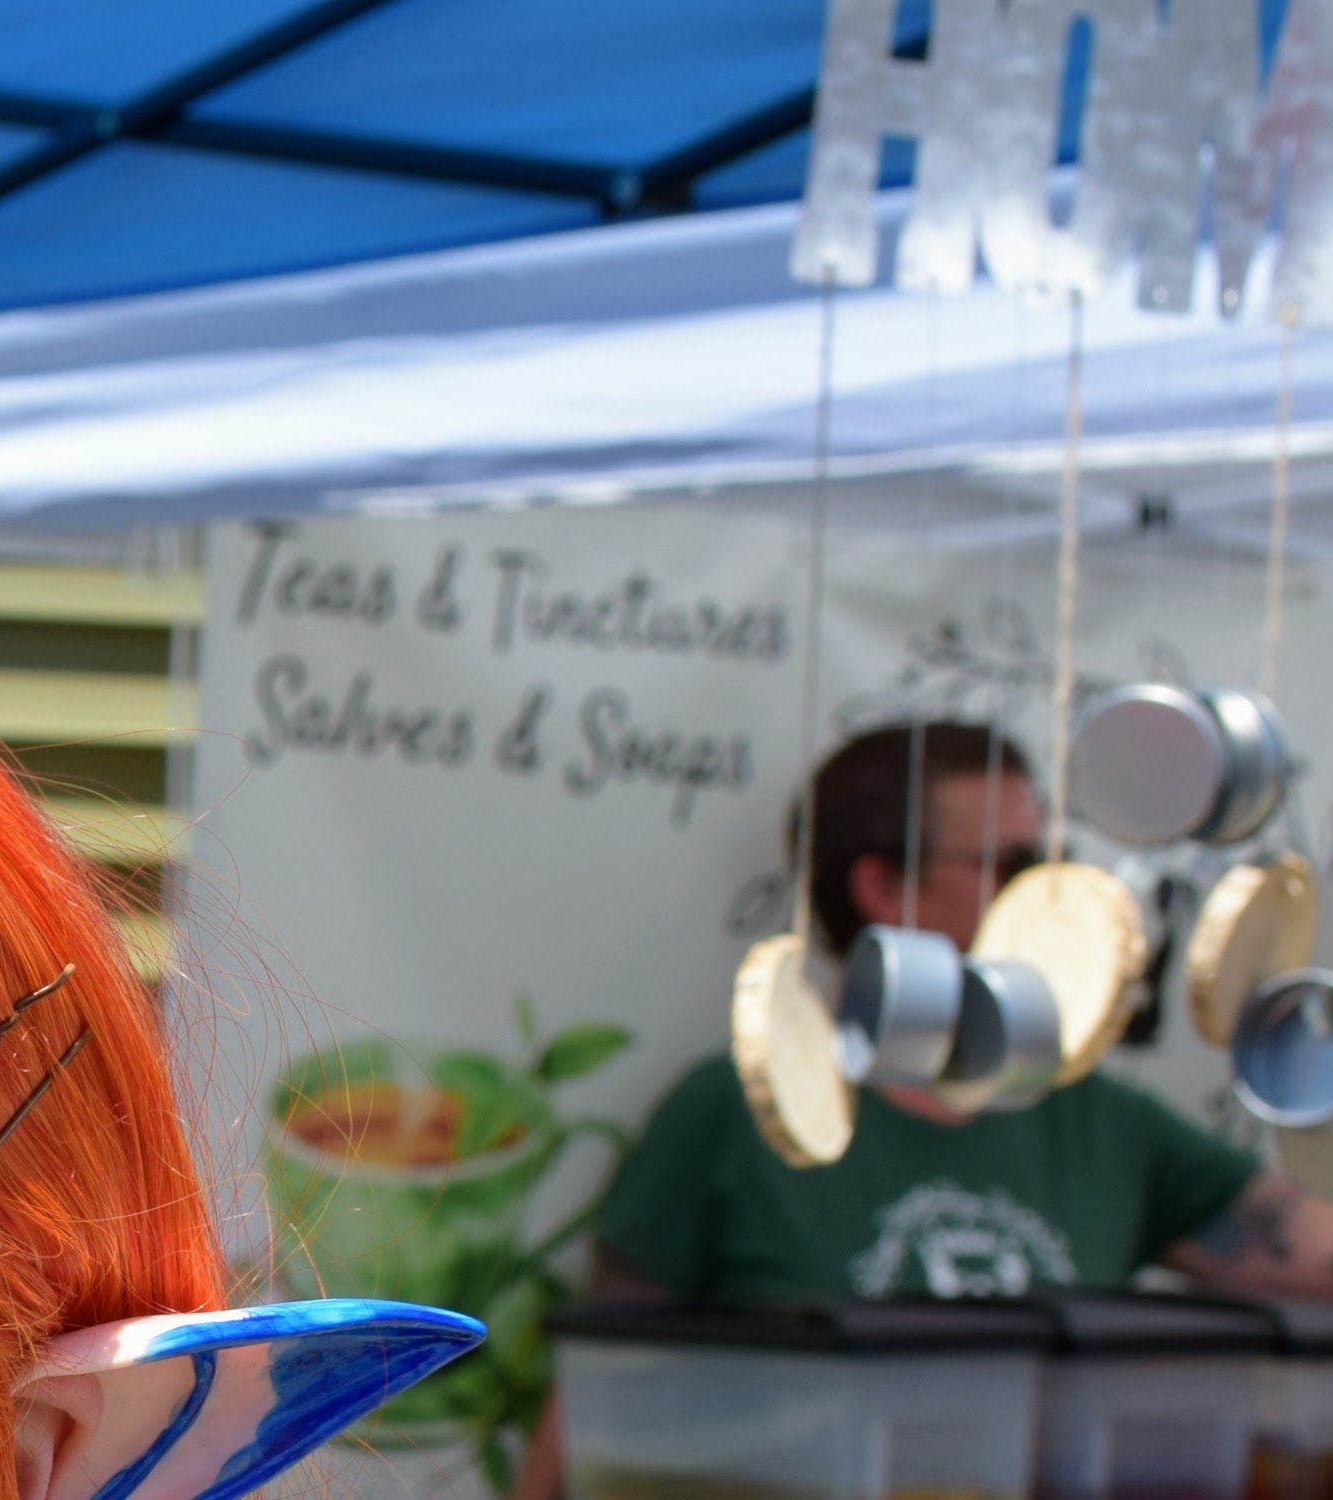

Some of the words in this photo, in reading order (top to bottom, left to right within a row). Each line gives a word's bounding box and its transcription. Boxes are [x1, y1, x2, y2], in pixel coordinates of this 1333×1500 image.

[236, 520, 397, 627] Teas
[490, 548, 792, 665] Tinctures
[246, 654, 473, 768] Salves
[565, 687, 754, 829] Soaps
